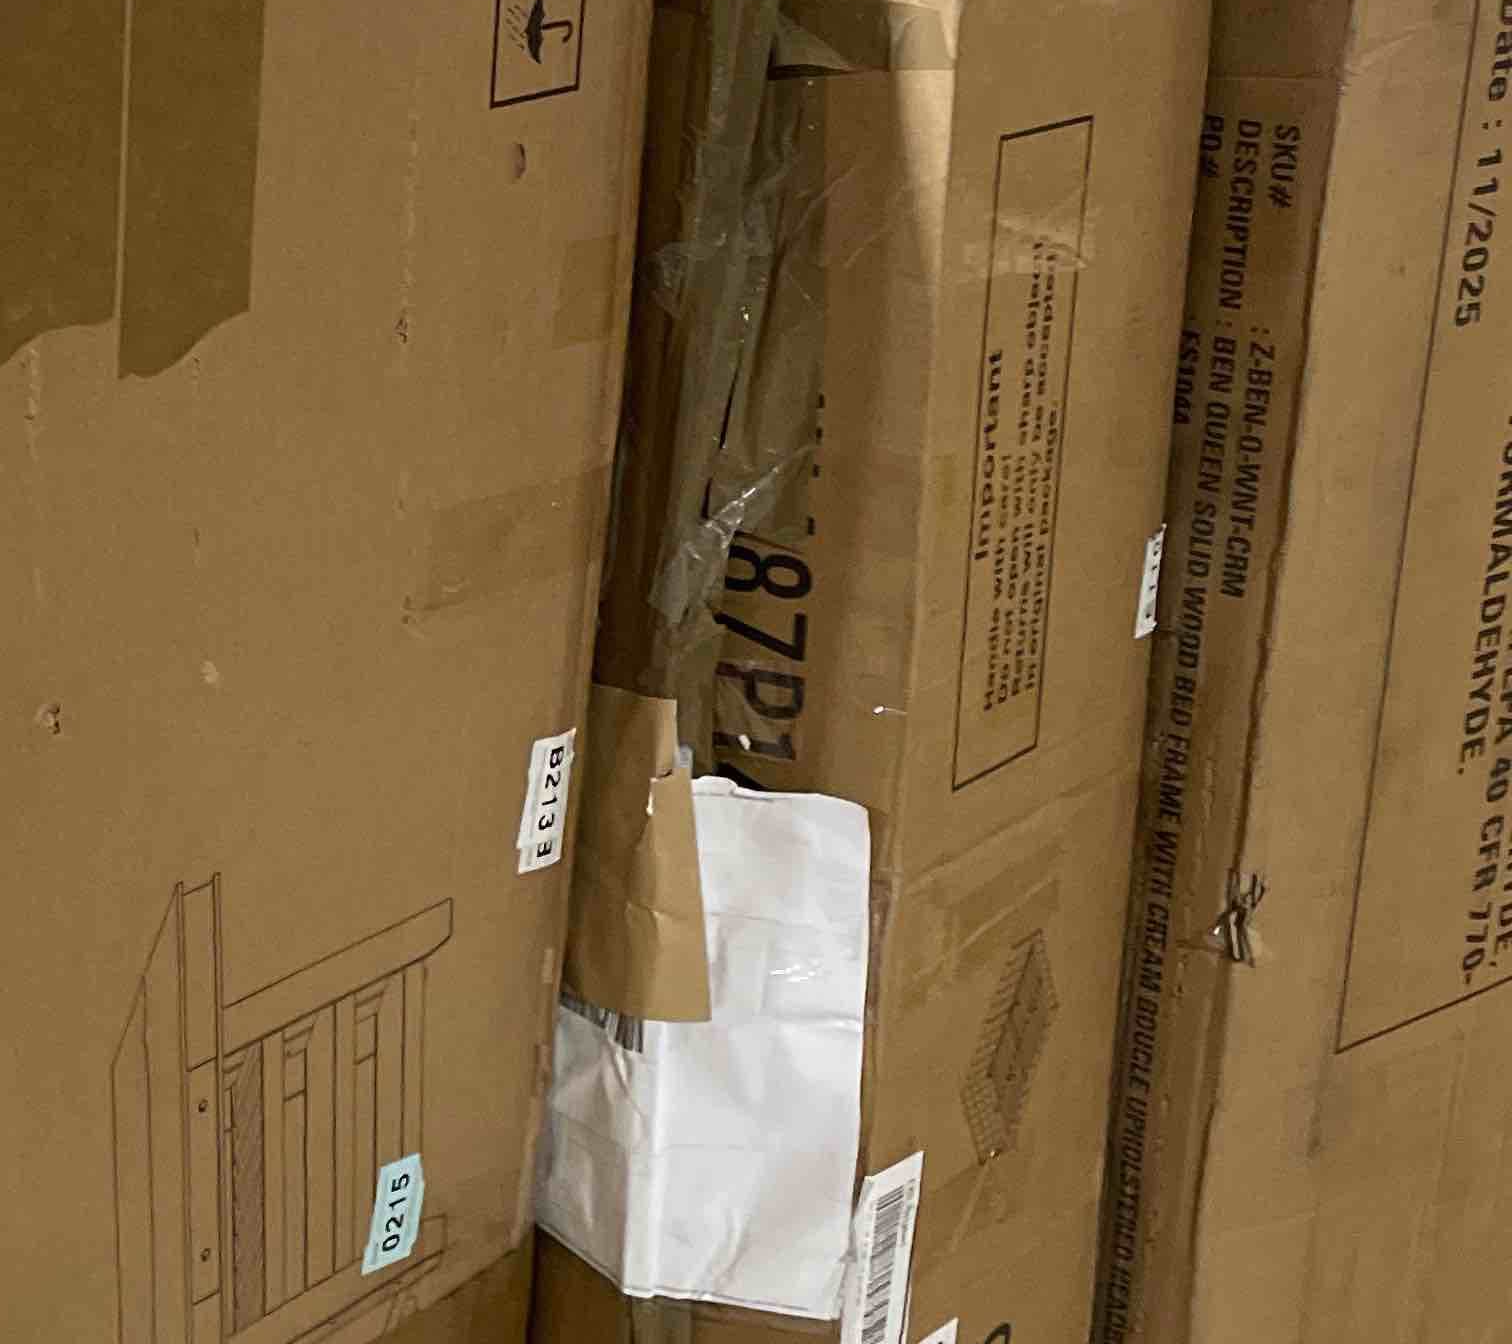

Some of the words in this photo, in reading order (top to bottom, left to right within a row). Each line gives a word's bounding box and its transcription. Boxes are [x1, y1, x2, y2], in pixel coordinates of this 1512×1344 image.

[1266, 122, 1302, 209] SKU#
[1217, 118, 1264, 311] DESCRIPTION
[1454, 148, 1504, 328] 11/2025
[1209, 336, 1236, 394] BEN
[974, 348, 1003, 561] Important
[1195, 400, 1232, 493] QUEEN
[1007, 526, 1021, 601] open
[1187, 500, 1217, 577] SOLID
[983, 606, 1001, 713] Handle
[992, 537, 1006, 601] with
[1178, 585, 1206, 669] WOOD
[1169, 674, 1199, 728] BED
[1156, 733, 1191, 826] FRAME
[1148, 830, 1179, 896] WITH
[1472, 815, 1505, 893] CFR
[1137, 905, 1172, 996] CREAM
